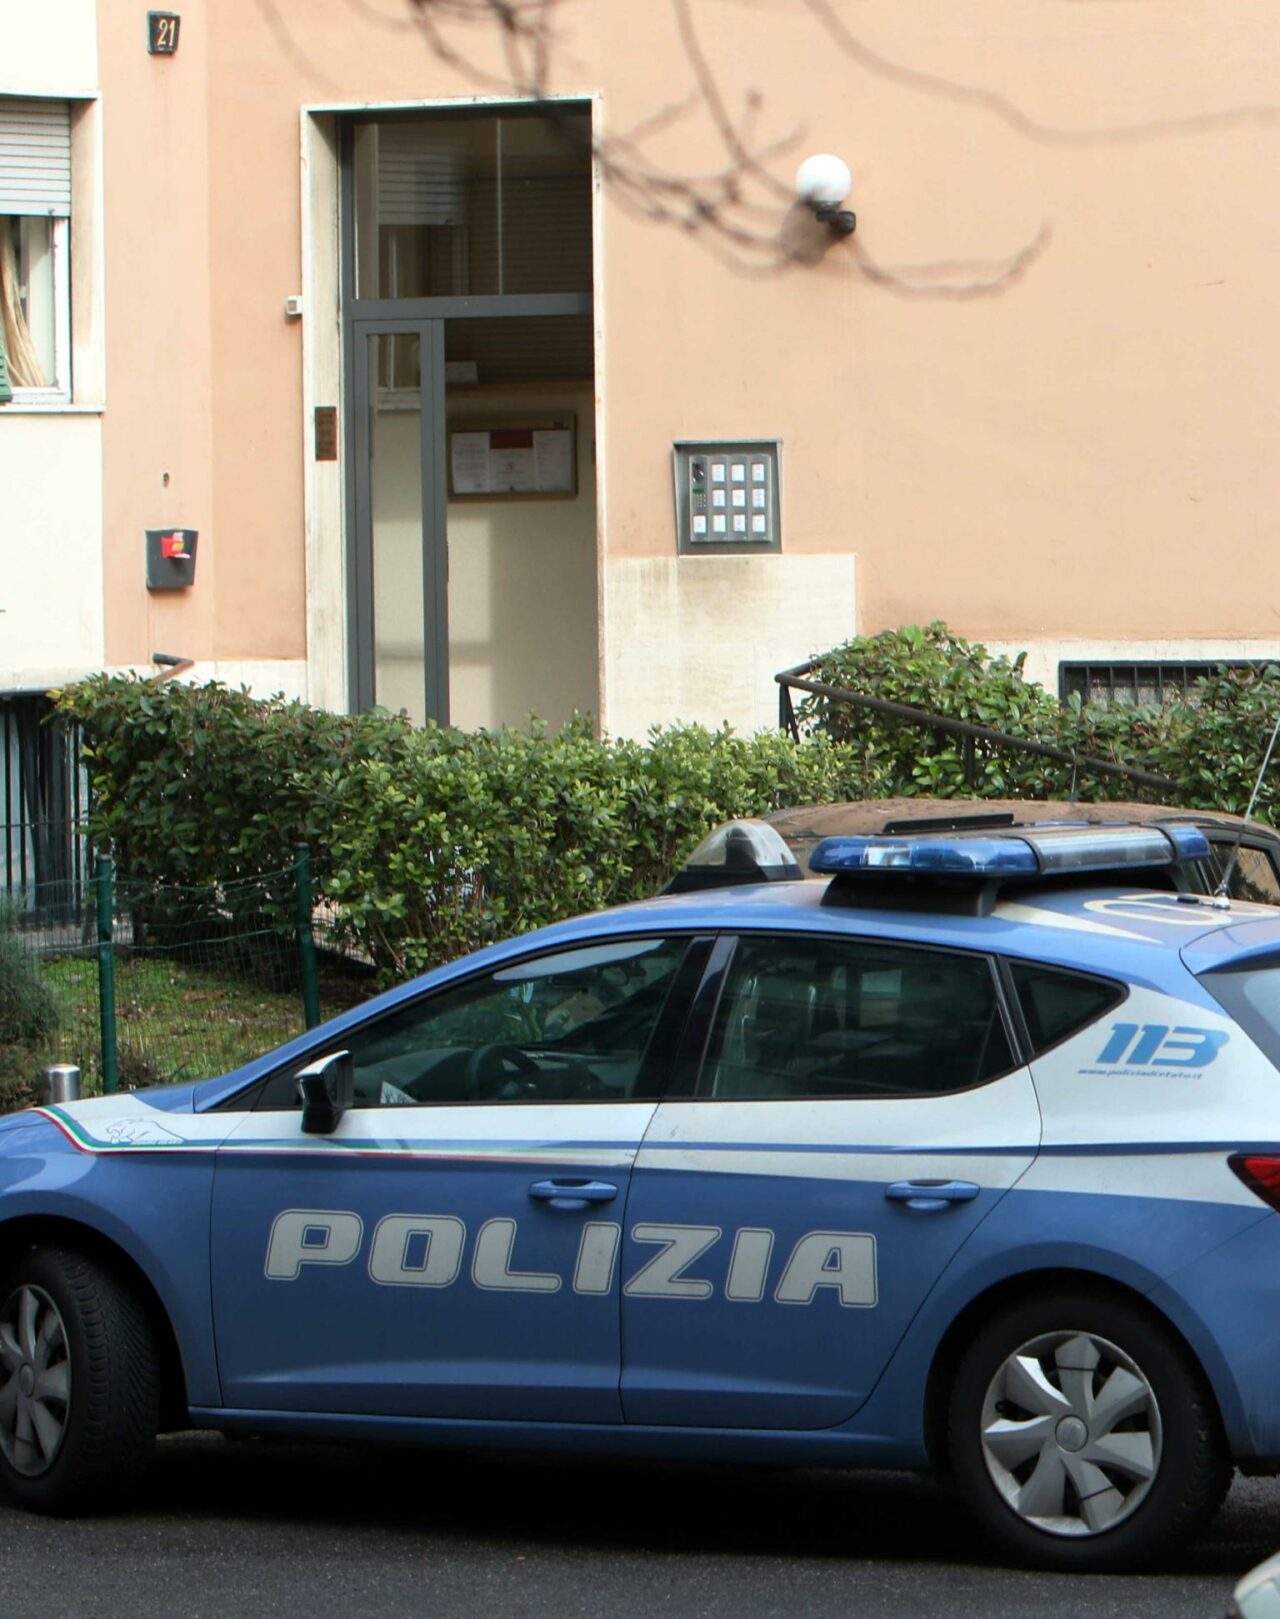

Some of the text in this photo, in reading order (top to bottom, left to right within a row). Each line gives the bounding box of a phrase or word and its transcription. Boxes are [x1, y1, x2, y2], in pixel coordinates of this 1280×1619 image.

[157, 18, 175, 46] 21
[1096, 1022, 1231, 1068] 113
[264, 1208, 879, 1308] POLIZIA
